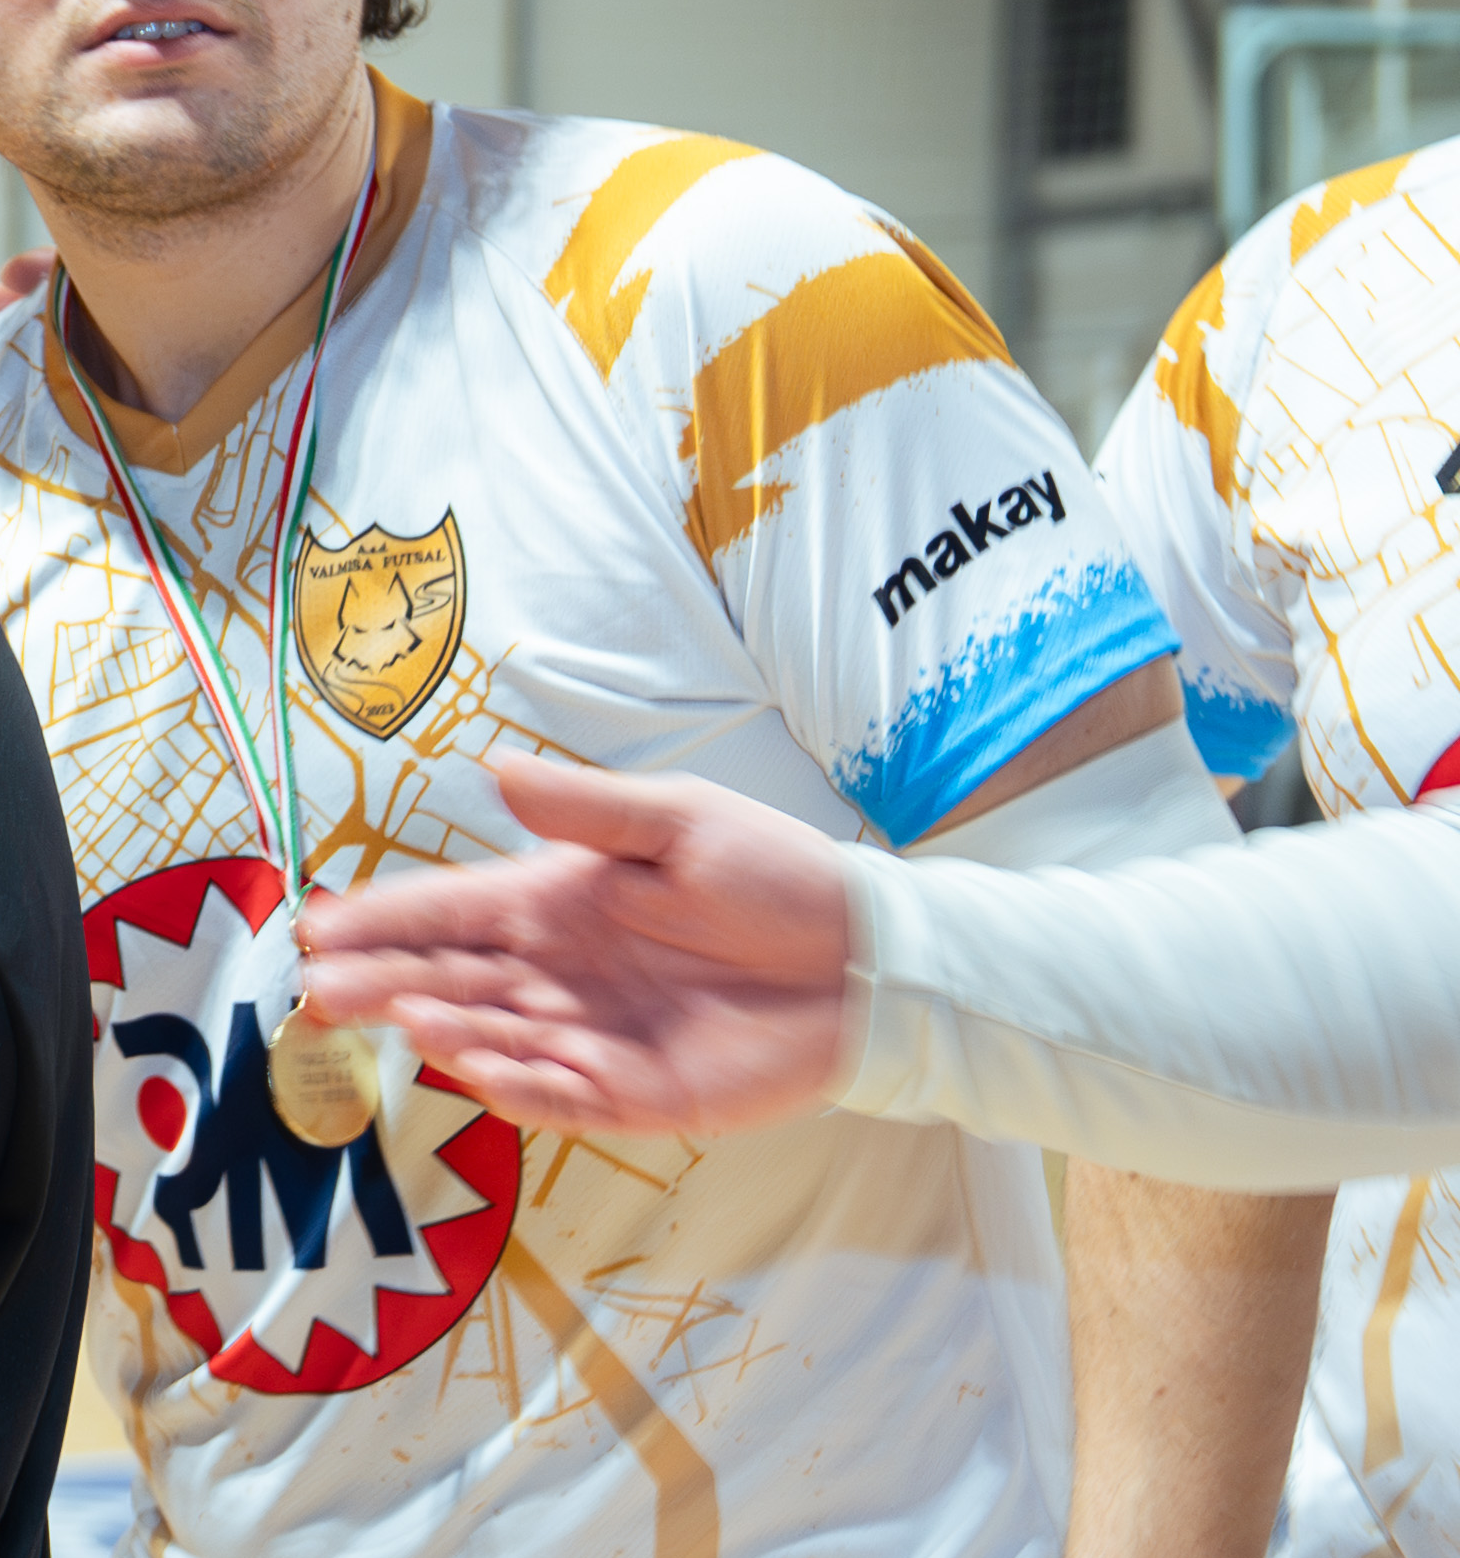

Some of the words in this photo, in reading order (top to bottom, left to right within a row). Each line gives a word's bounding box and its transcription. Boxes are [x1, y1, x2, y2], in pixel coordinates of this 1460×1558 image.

[309, 558, 373, 579] VALMISA
[383, 549, 447, 568] FUTSAL
[871, 470, 1067, 630] makay
